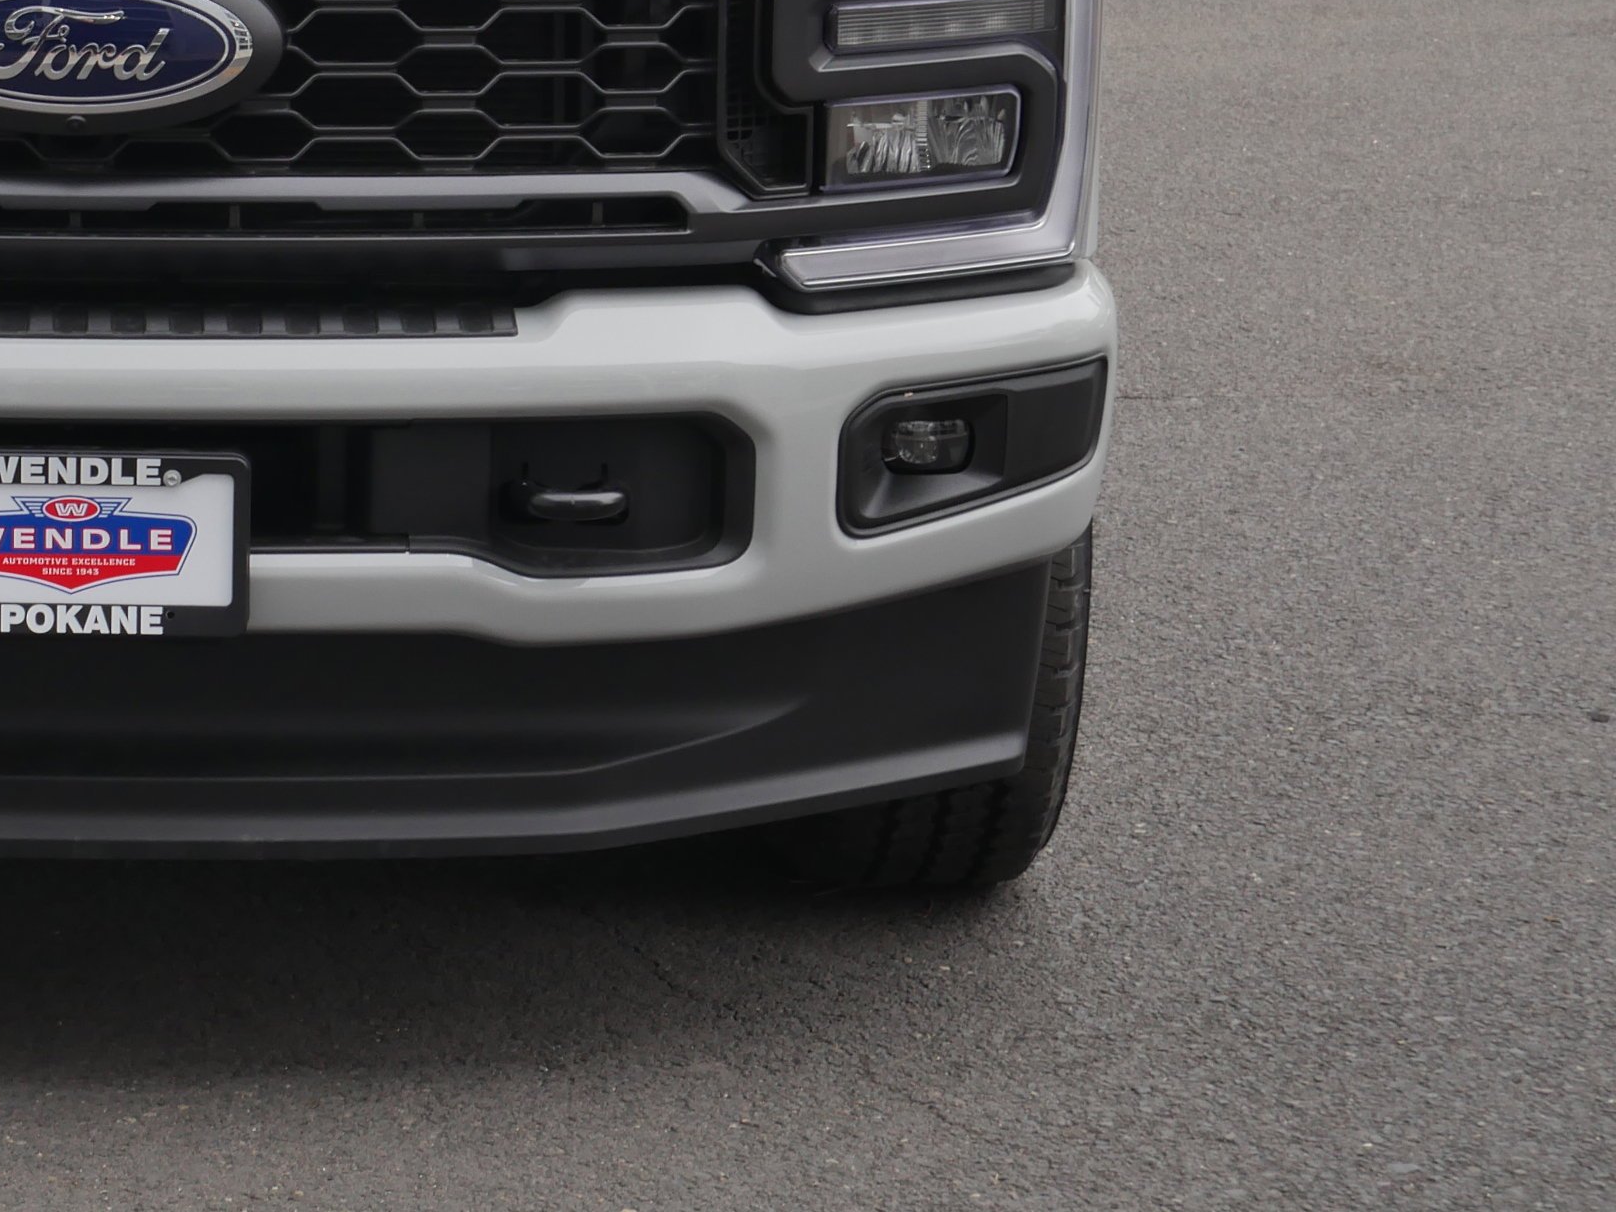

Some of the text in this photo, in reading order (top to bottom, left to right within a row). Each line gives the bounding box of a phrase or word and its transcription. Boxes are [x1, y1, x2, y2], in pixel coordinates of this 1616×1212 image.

[2, 557, 136, 566] AUTOMOTIVE EXCELLENCE
[42, 567, 73, 575] SINCE
